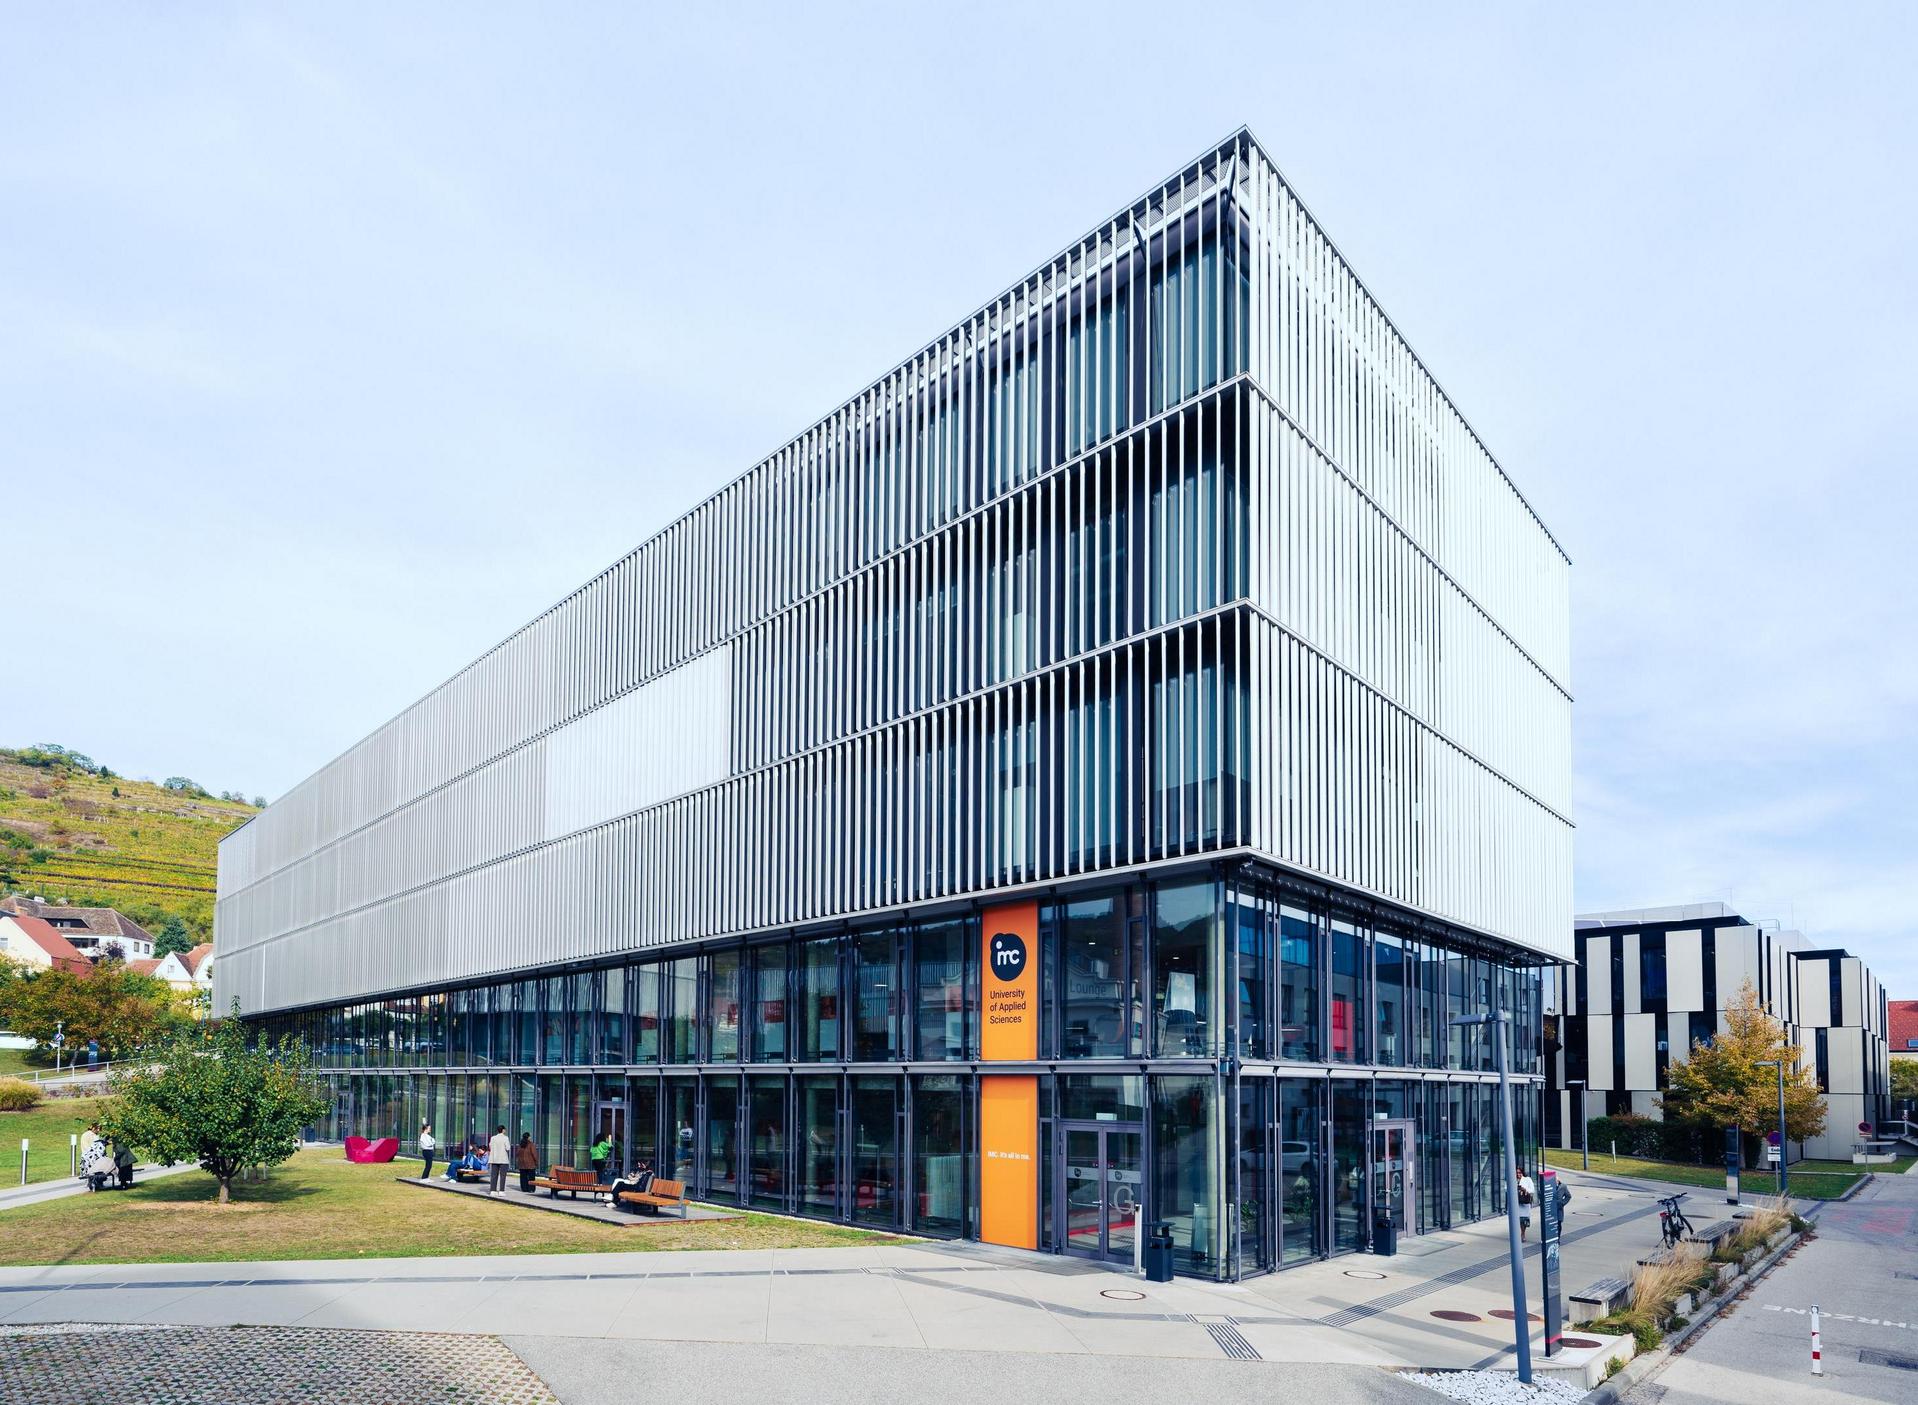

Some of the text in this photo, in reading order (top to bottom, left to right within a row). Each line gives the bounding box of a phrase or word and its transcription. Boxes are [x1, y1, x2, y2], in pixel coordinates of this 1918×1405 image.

[996, 941, 1020, 966] imc
[989, 989, 1025, 1000] University
[989, 1001, 1026, 1013] of Applied
[989, 1015, 1022, 1024] Sciences
[1114, 1185, 1135, 1215] G
